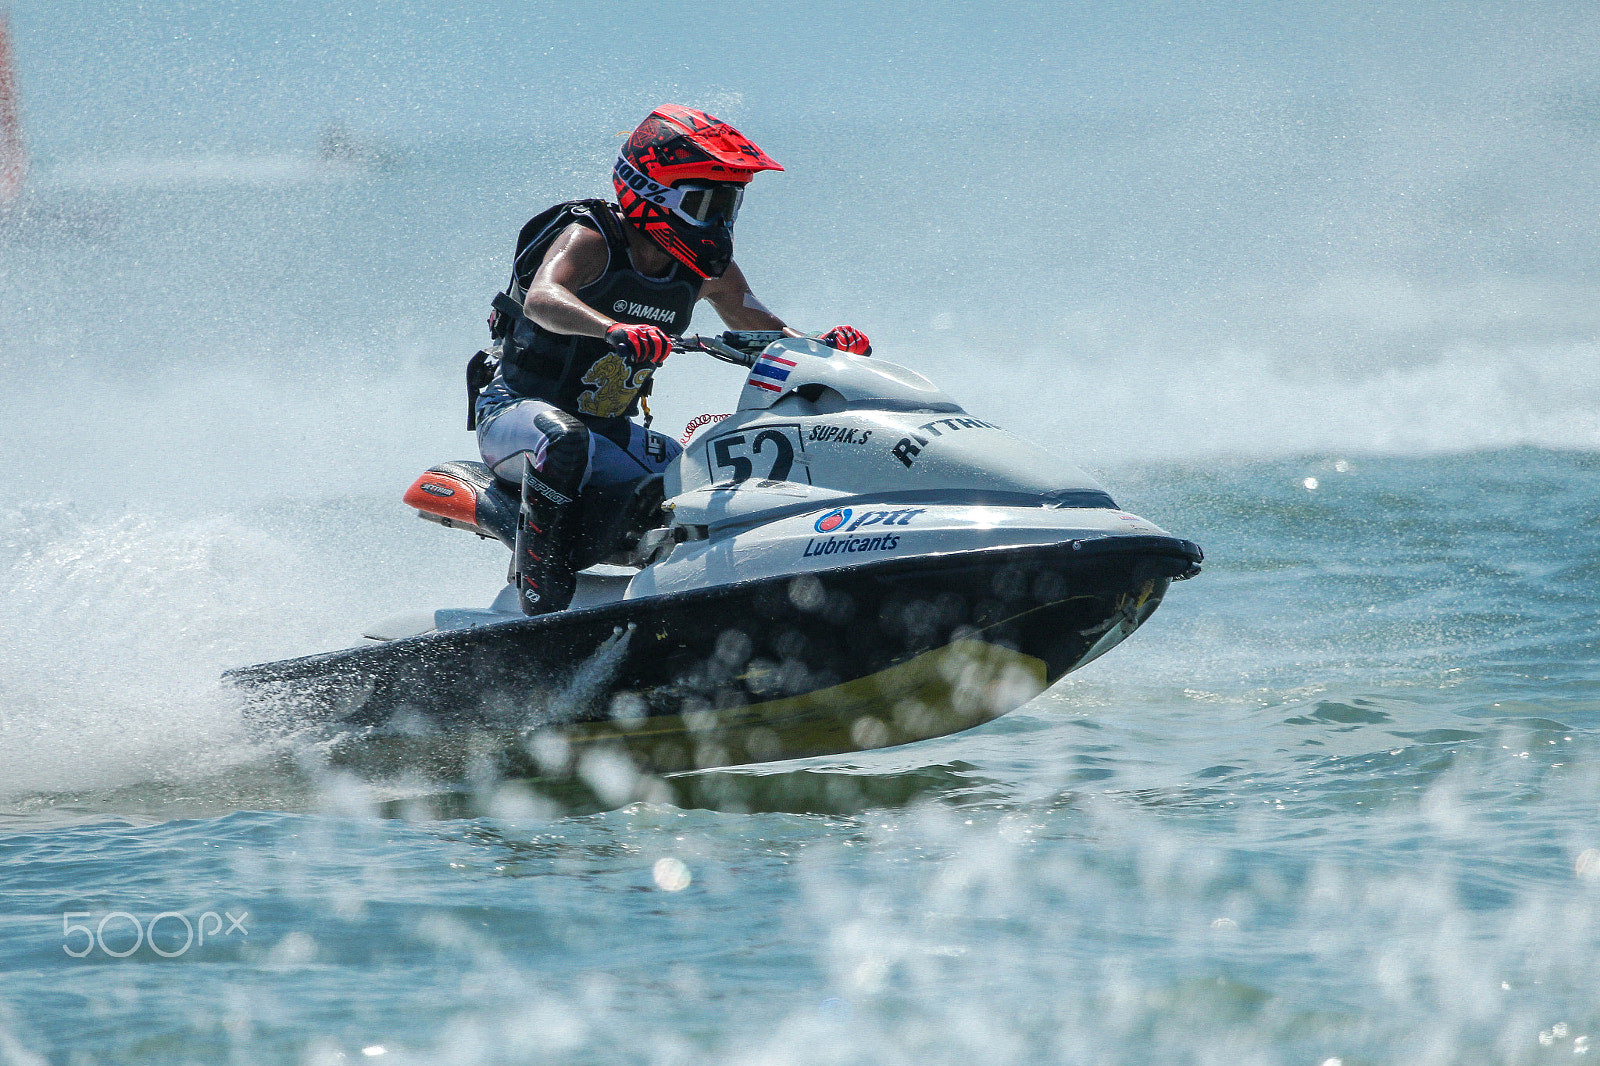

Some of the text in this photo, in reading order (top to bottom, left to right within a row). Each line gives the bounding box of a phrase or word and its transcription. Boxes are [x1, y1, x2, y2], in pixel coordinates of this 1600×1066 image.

[613, 157, 671, 204] 100%
[626, 302, 676, 325] YAMAHA
[809, 424, 872, 445] SUPAK.S
[713, 429, 795, 488] 52
[845, 507, 927, 532] ptt
[802, 532, 900, 558] Lubricants
